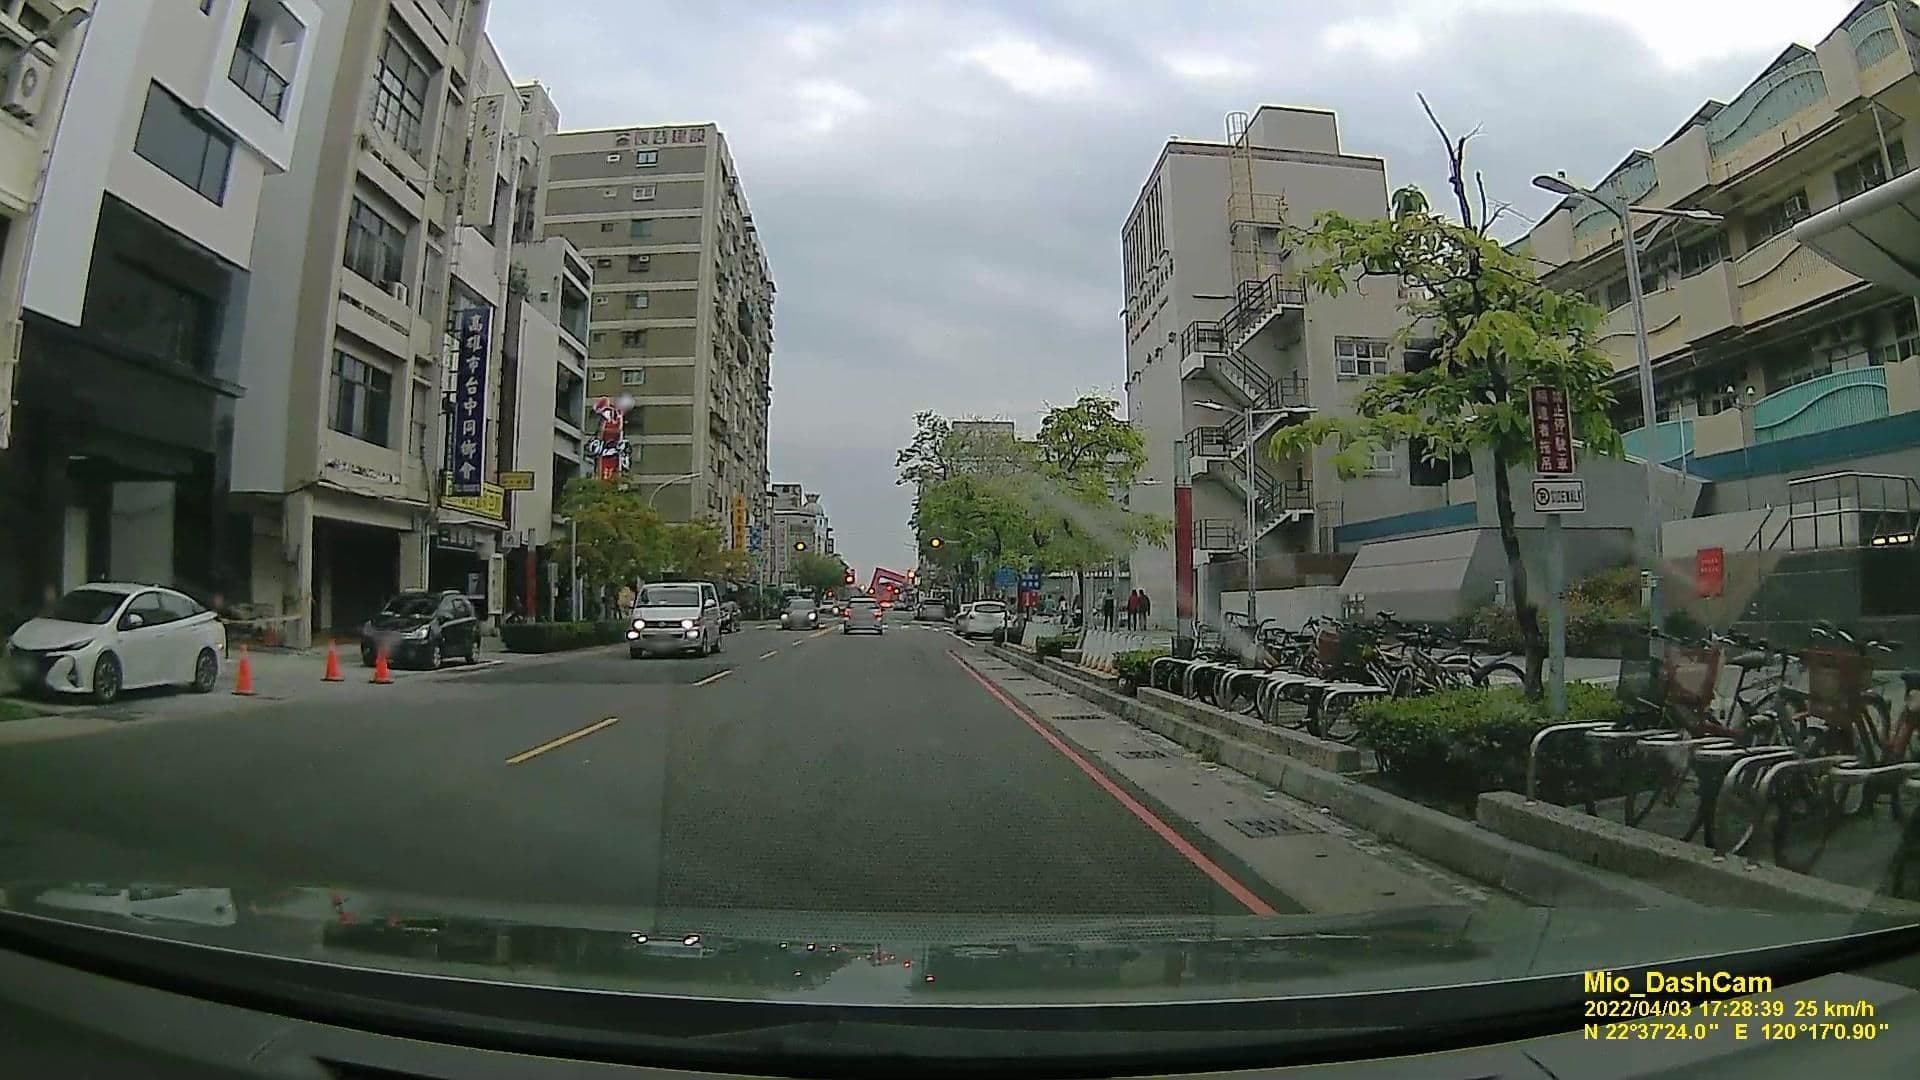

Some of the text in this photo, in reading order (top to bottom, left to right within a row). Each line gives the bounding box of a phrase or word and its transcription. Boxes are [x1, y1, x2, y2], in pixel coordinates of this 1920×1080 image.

[458, 314, 484, 480] 高雄市台中同鄉會
